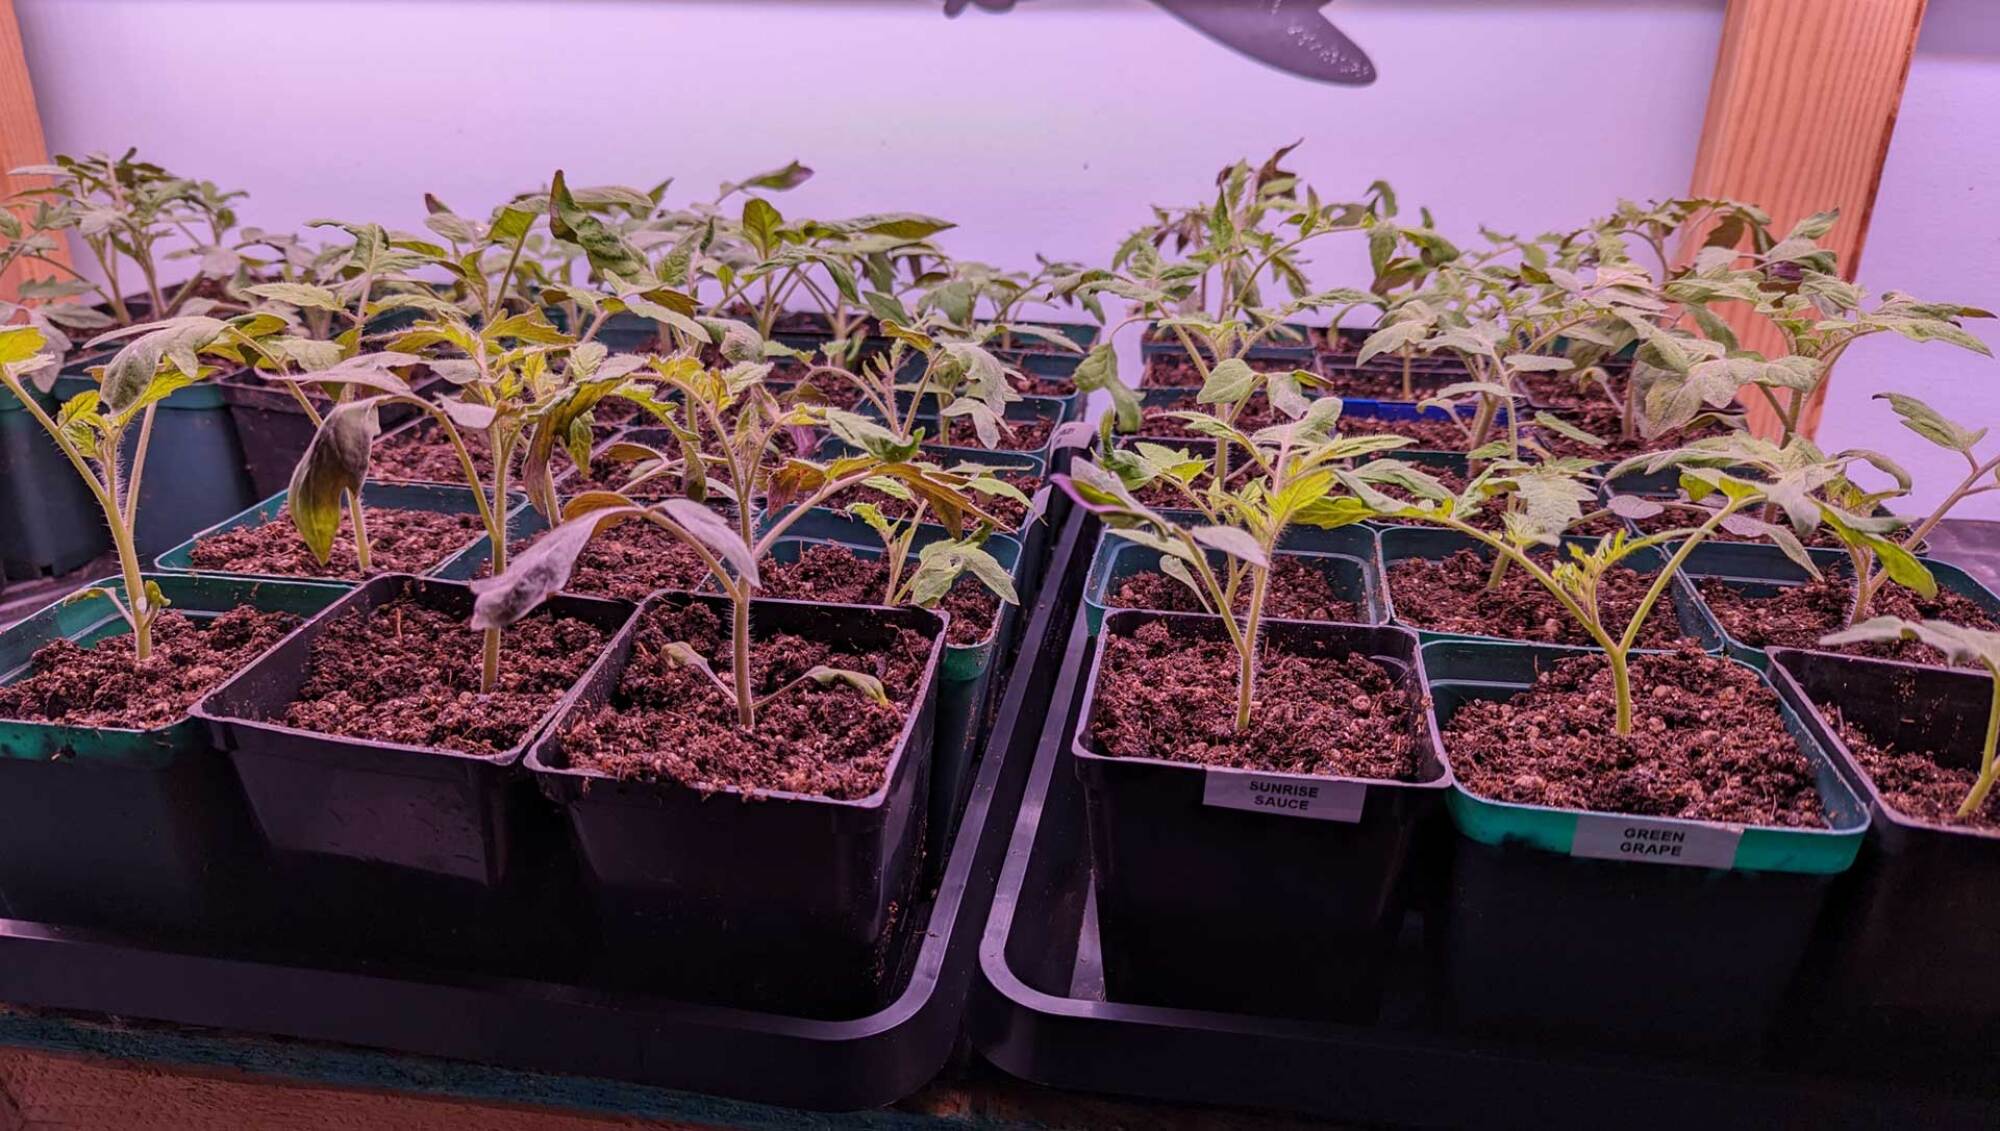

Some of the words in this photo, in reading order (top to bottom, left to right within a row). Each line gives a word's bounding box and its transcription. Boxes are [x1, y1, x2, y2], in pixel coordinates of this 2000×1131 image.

[1249, 781, 1319, 798] SUNRISE
[1254, 795, 1309, 810] SAUCE
[1624, 828, 1685, 842] GREEN
[1620, 842, 1682, 856] GRAPE
